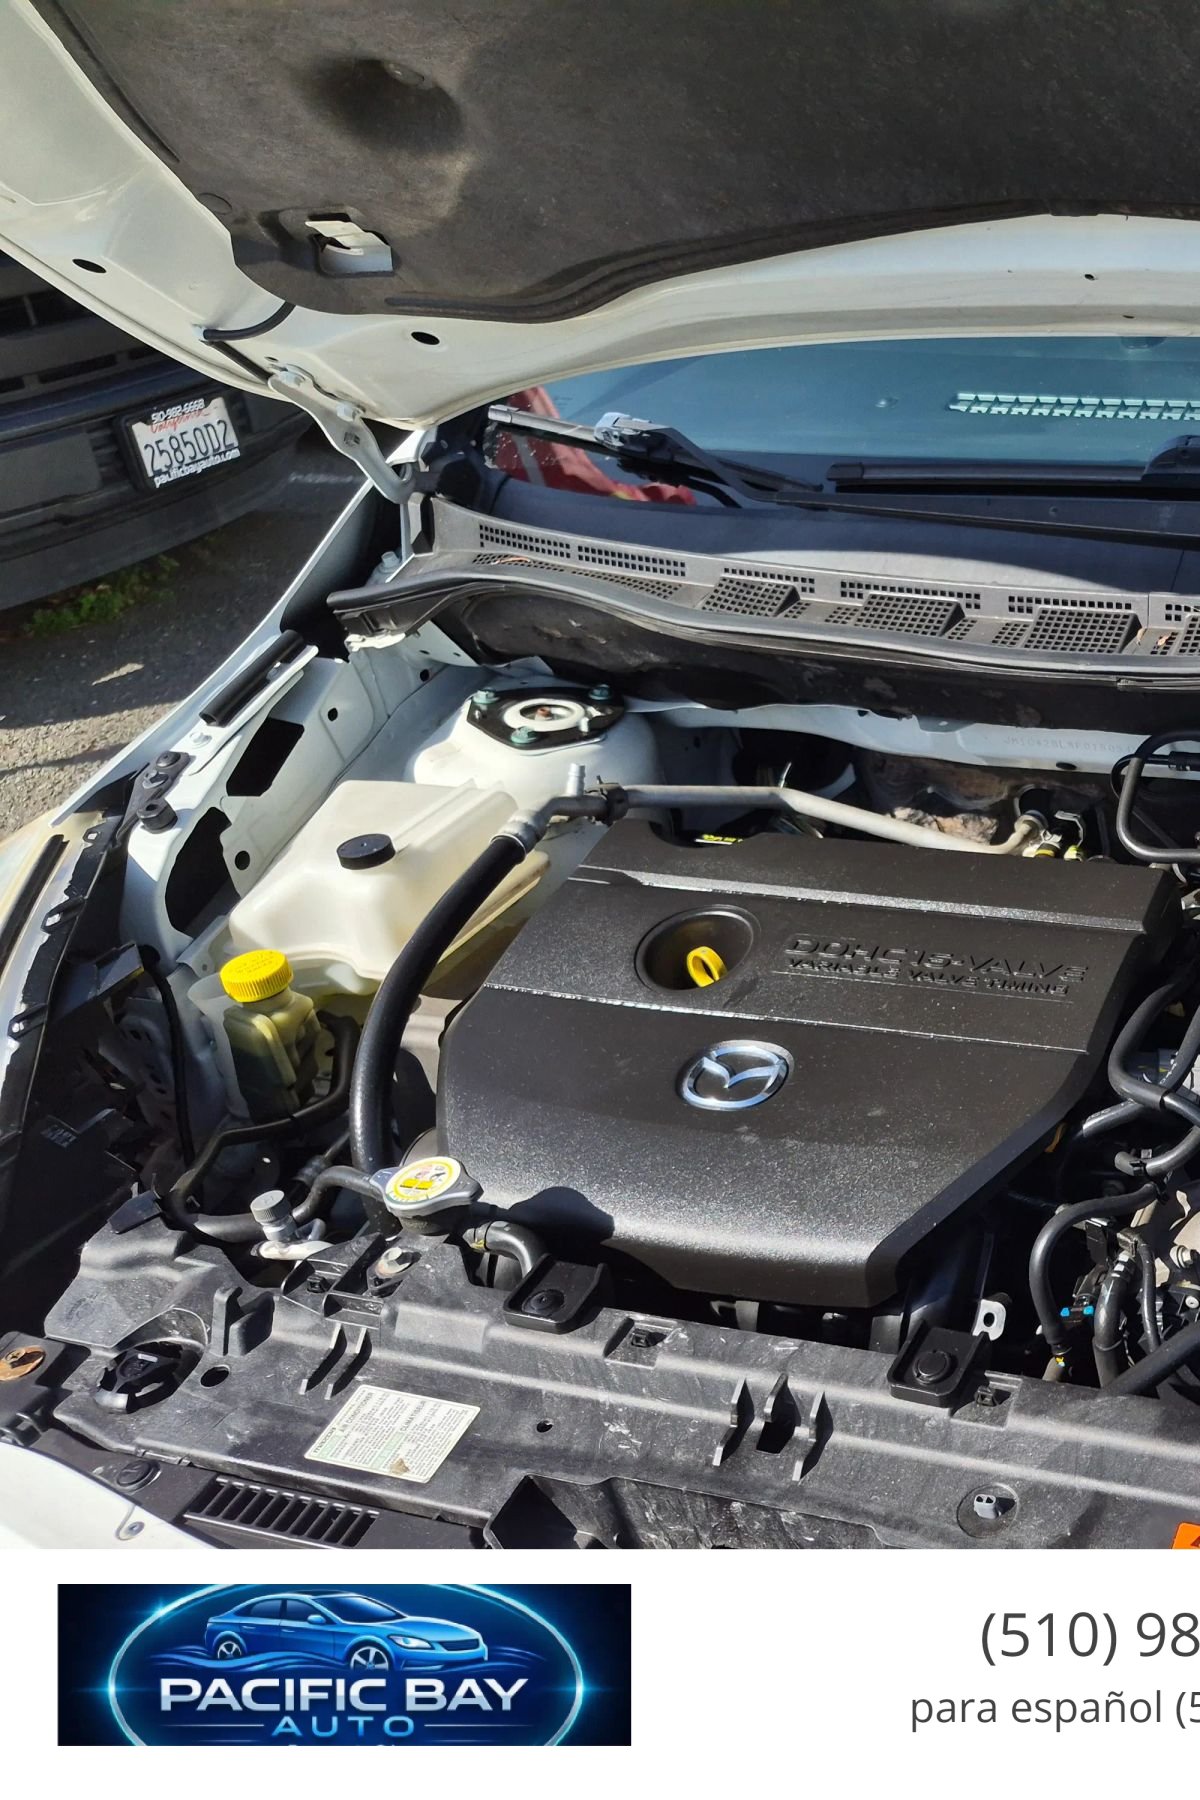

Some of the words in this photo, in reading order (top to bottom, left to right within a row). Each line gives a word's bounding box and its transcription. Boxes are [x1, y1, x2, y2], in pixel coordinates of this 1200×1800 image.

[144, 419, 235, 474] 25850D2
[785, 939, 907, 965] DOHC
[788, 958, 900, 980] VARIABLE
[907, 969, 980, 988] VALVE
[983, 977, 1070, 996] TIMING
